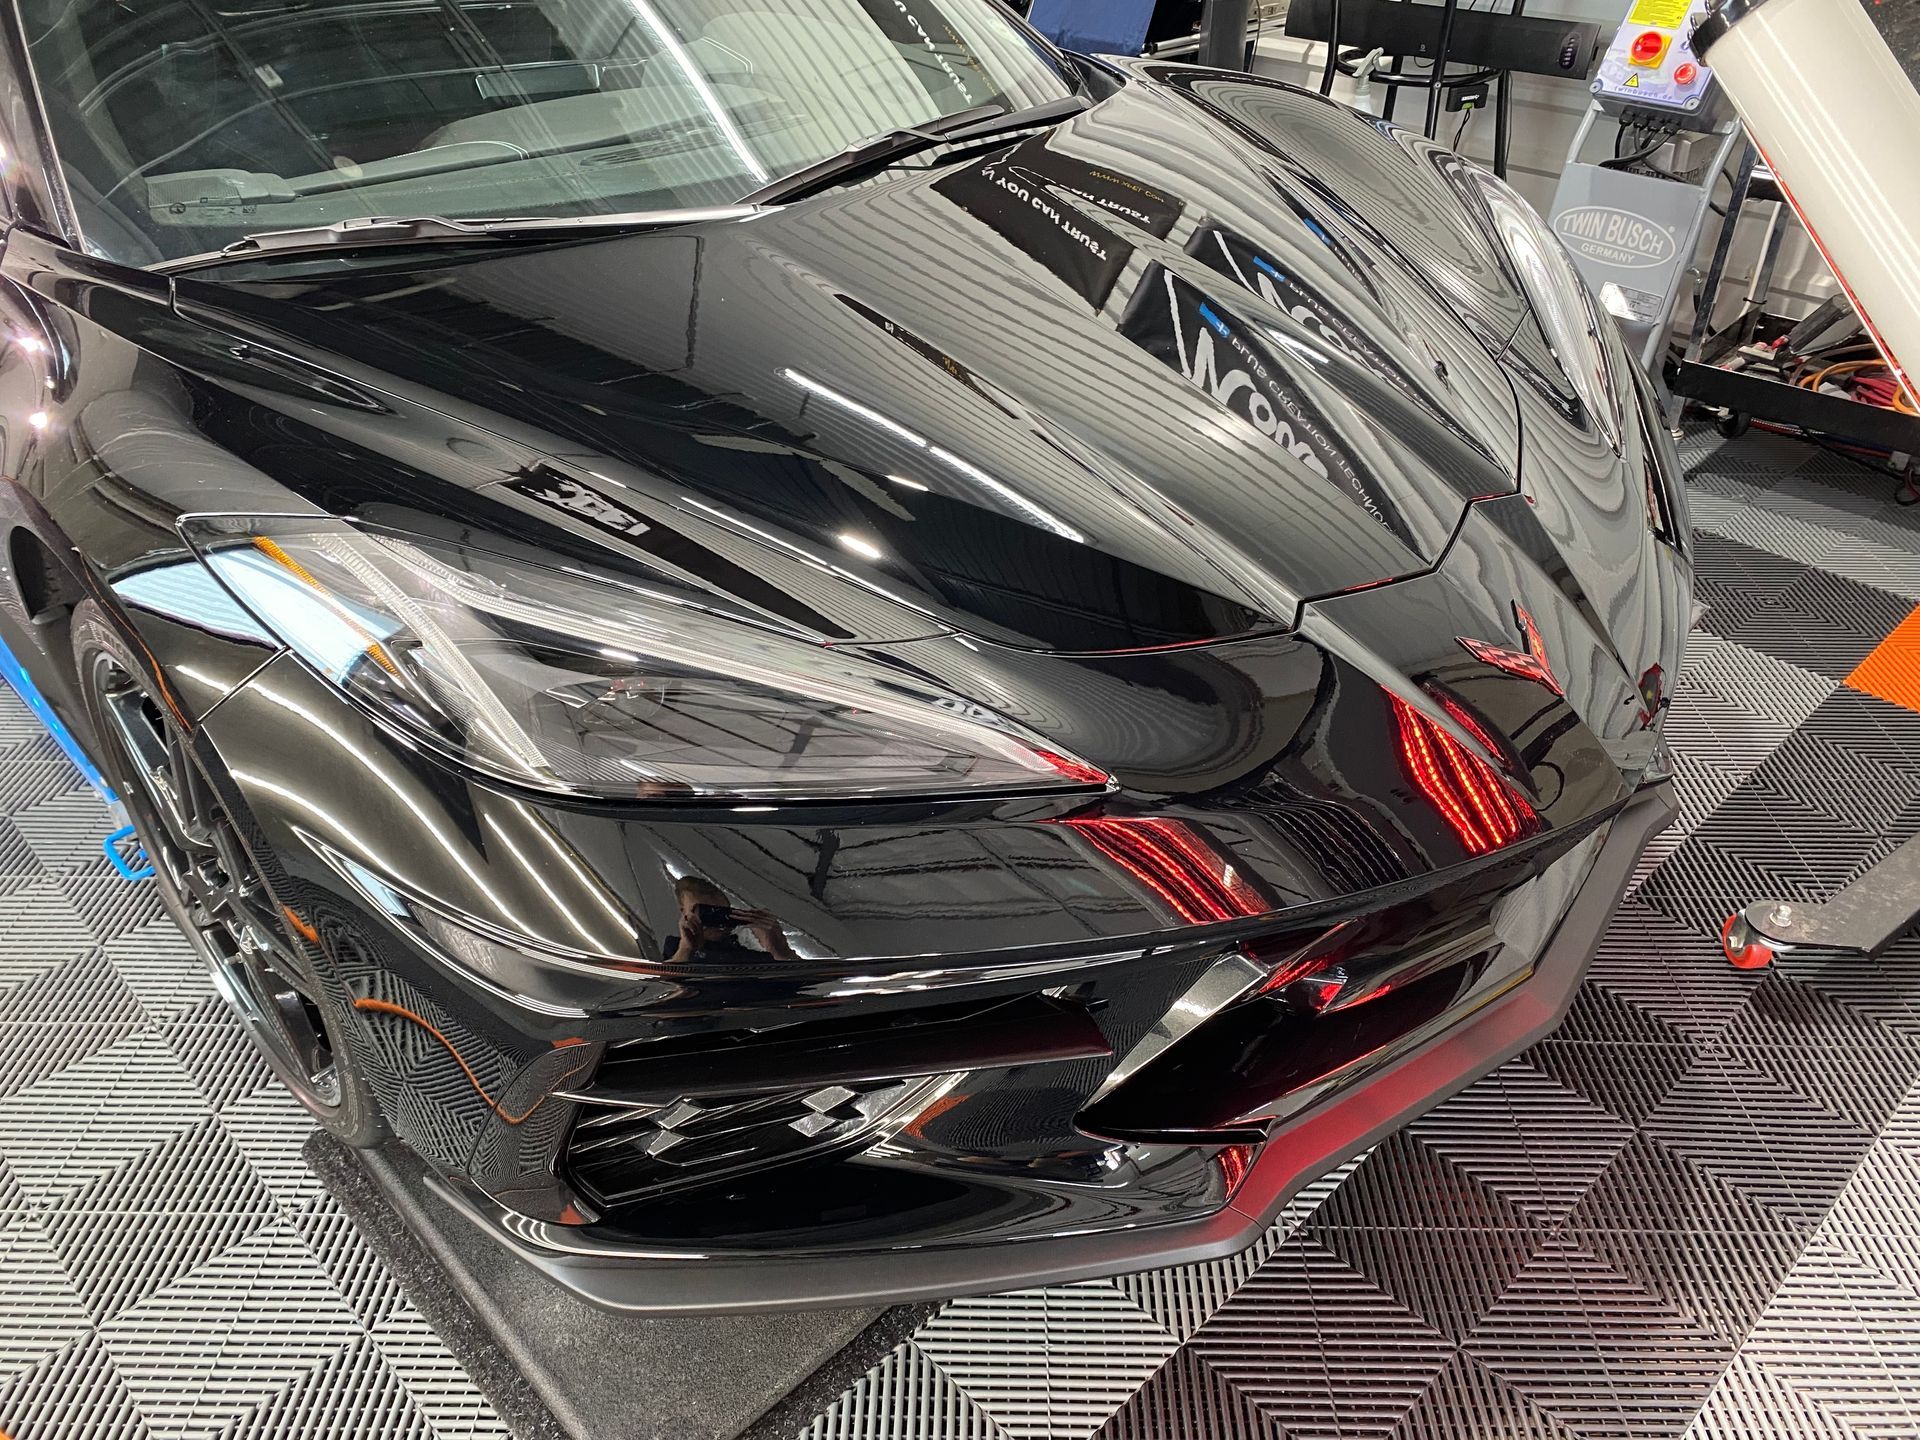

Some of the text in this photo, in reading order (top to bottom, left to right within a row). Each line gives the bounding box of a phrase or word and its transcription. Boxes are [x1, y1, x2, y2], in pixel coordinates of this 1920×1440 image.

[1563, 211, 1664, 255] TWIN BUSCH
[1580, 242, 1635, 263] GERMANY
